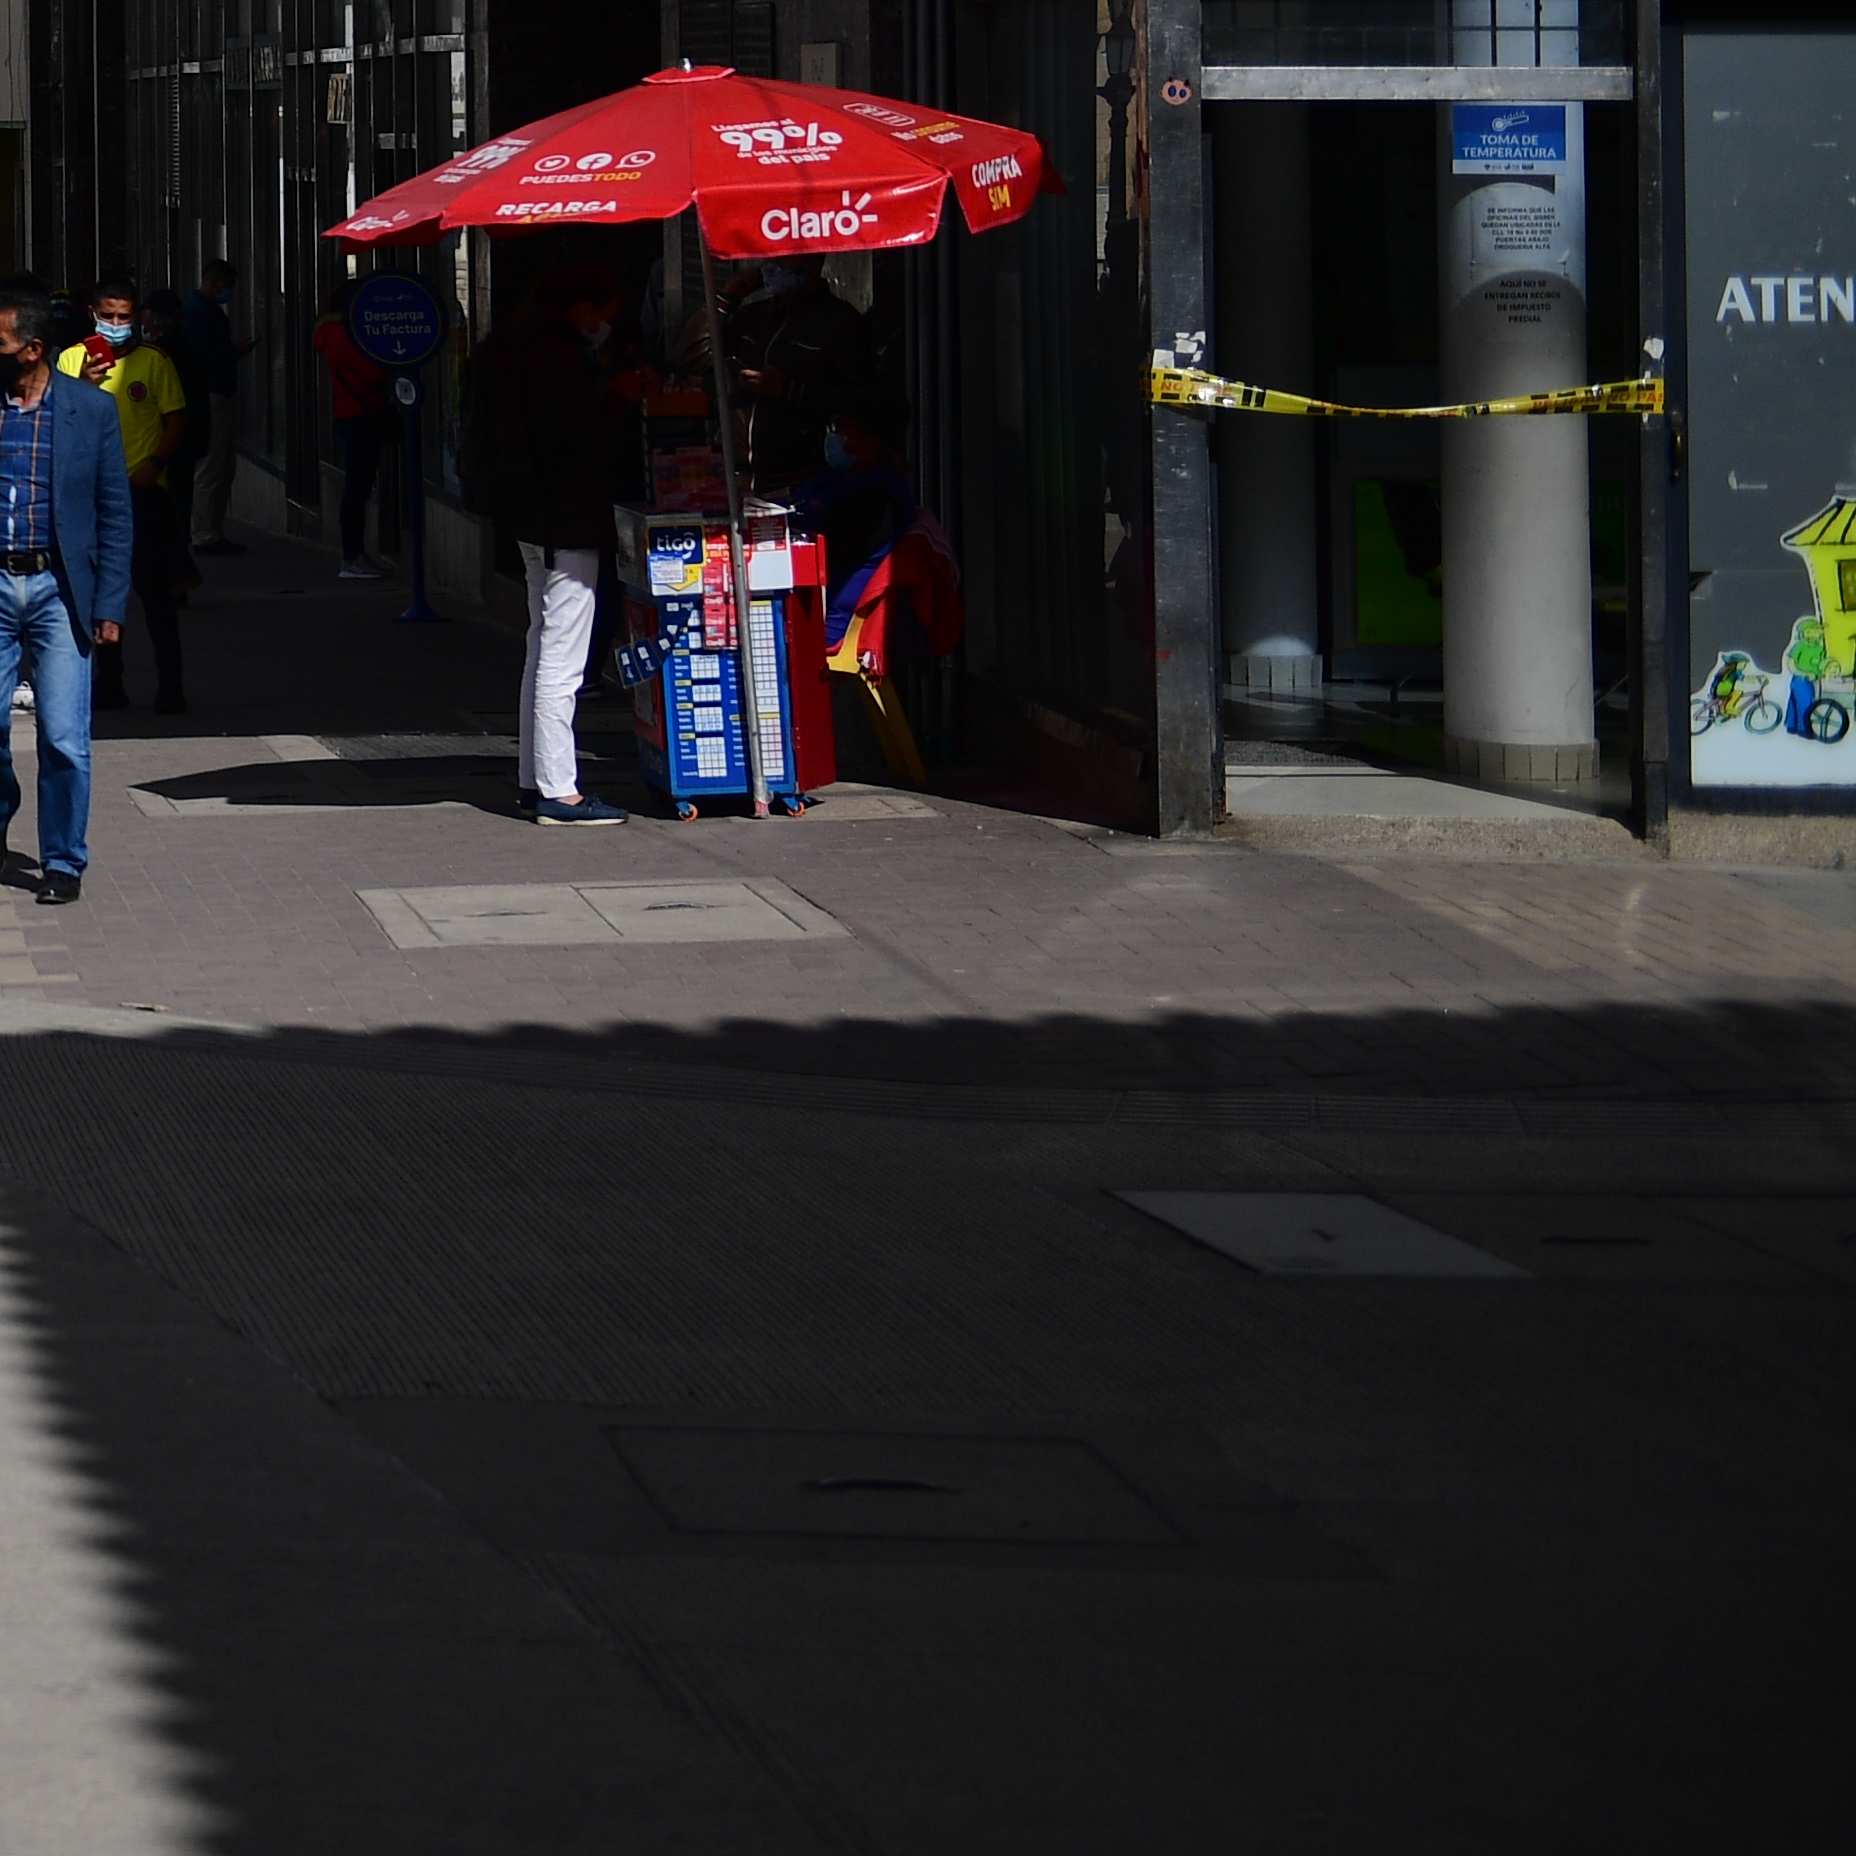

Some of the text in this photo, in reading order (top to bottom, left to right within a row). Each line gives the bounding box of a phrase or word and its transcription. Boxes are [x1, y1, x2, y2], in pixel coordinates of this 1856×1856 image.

[710, 120, 778, 132] Llegamos
[719, 122, 843, 152] 99%
[1479, 134, 1538, 146] TOMA DE
[774, 146, 838, 155] municipios
[1462, 146, 1556, 158] TEMPERATURA
[758, 154, 790, 164] del
[971, 154, 1022, 188] COMPRA
[988, 184, 1010, 212] SIM
[495, 200, 617, 216] RECARGA
[761, 196, 871, 240] Claro
[1484, 292, 1528, 300] ENTREGAN
[1715, 277, 1855, 322] ATEN
[1496, 304, 1507, 312] DE
[364, 310, 425, 322] Descarga
[1508, 315, 1542, 323] PREDIAL
[364, 324, 432, 336] Tu Factura
[1160, 380, 1184, 392] NO
[1606, 390, 1630, 403] NO
